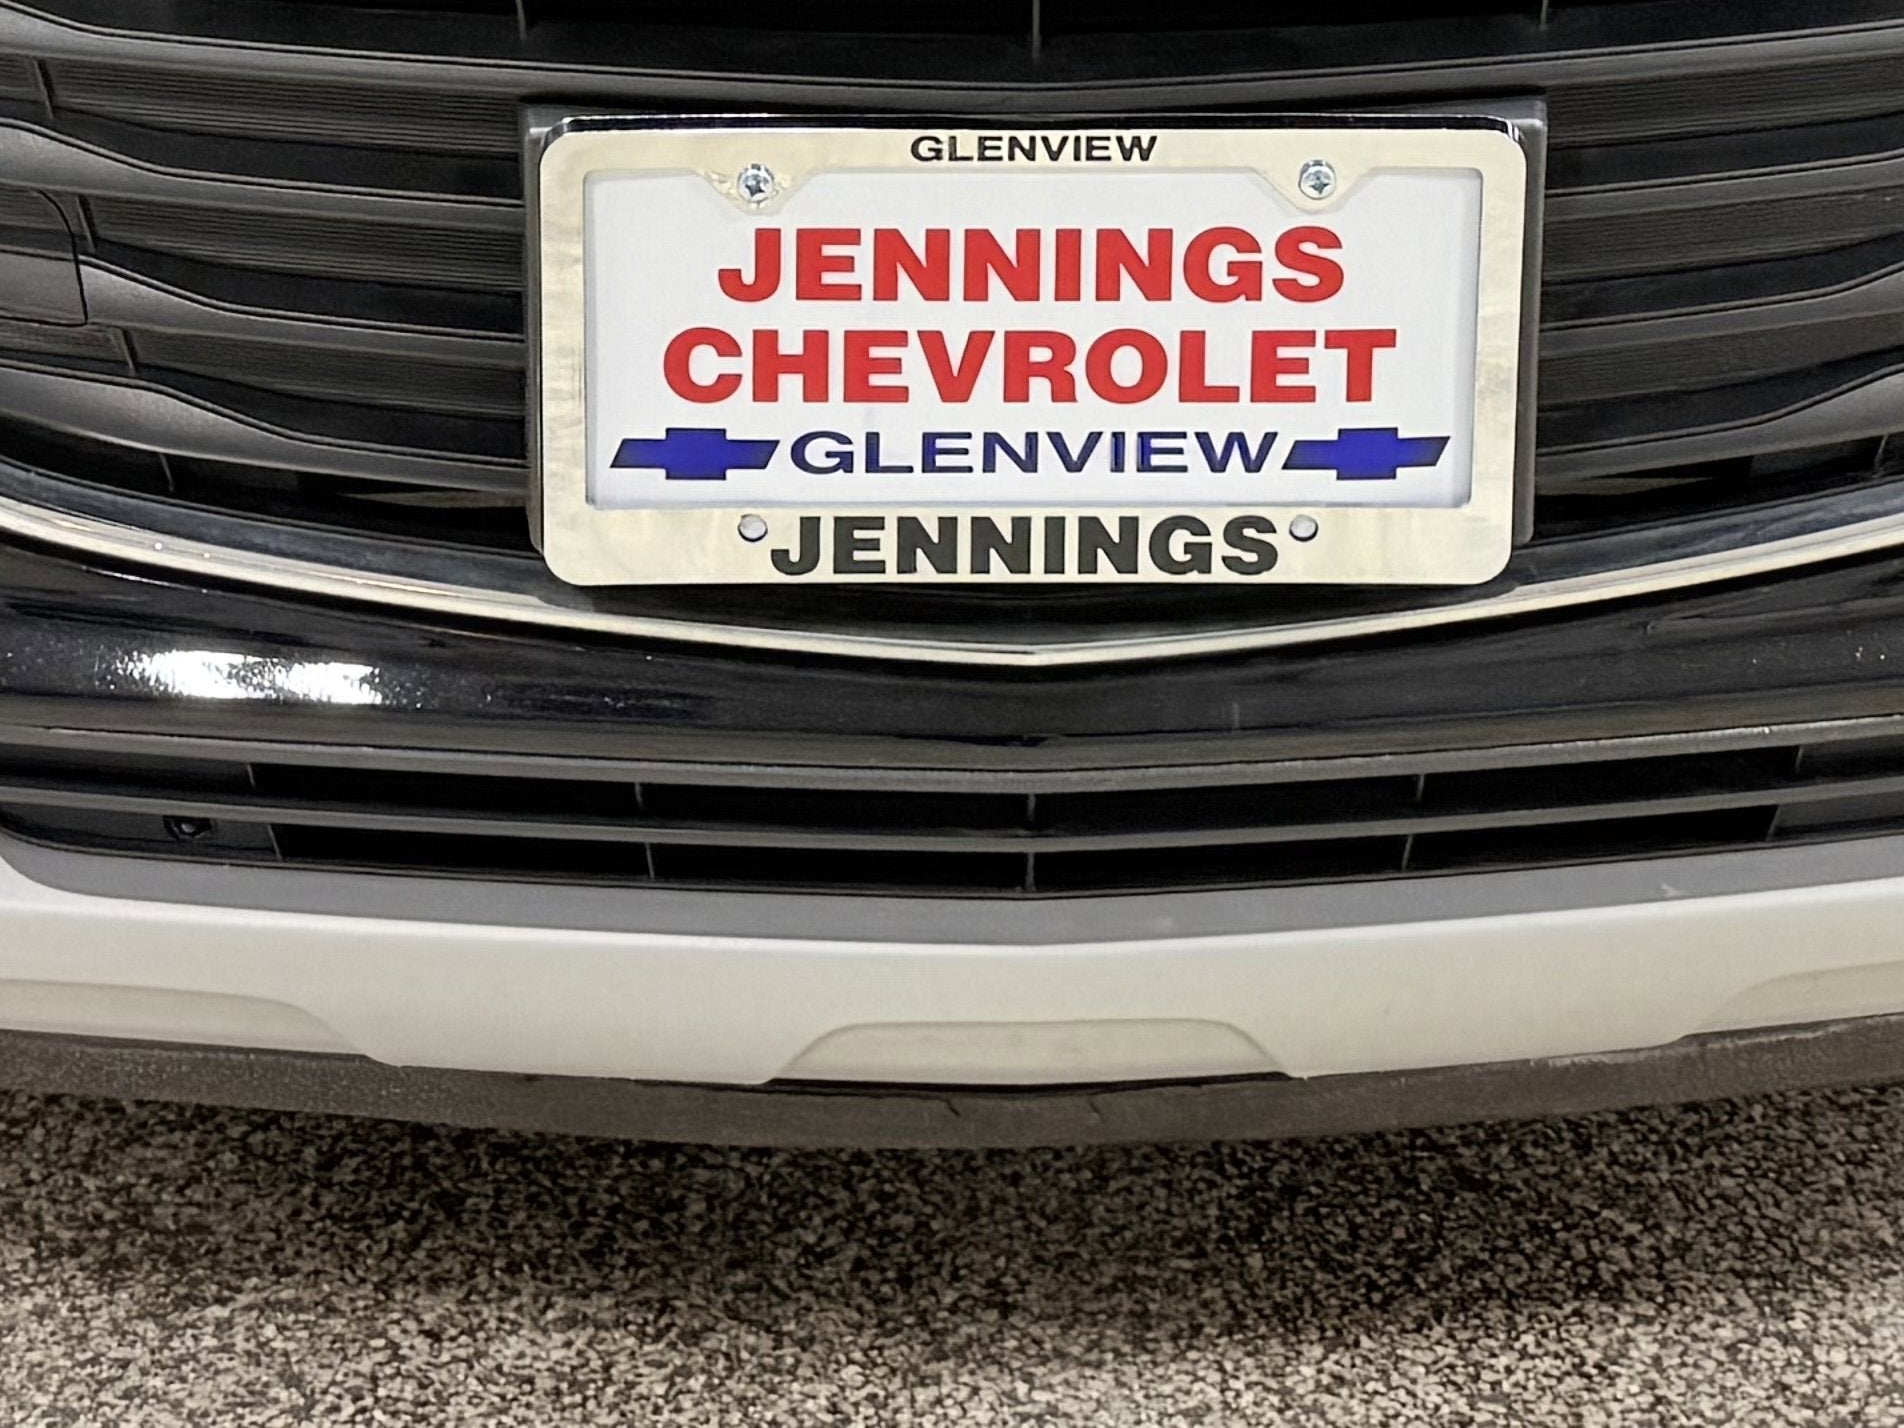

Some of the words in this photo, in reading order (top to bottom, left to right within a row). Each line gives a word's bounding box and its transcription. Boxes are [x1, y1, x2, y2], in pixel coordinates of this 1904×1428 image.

[909, 135, 1158, 163] GLENVIEW
[717, 225, 1345, 304] JENNINGS
[663, 327, 1397, 405] CHEVROLET
[790, 430, 1279, 475] GLENVIEW
[770, 515, 1279, 577] JENNINGS
